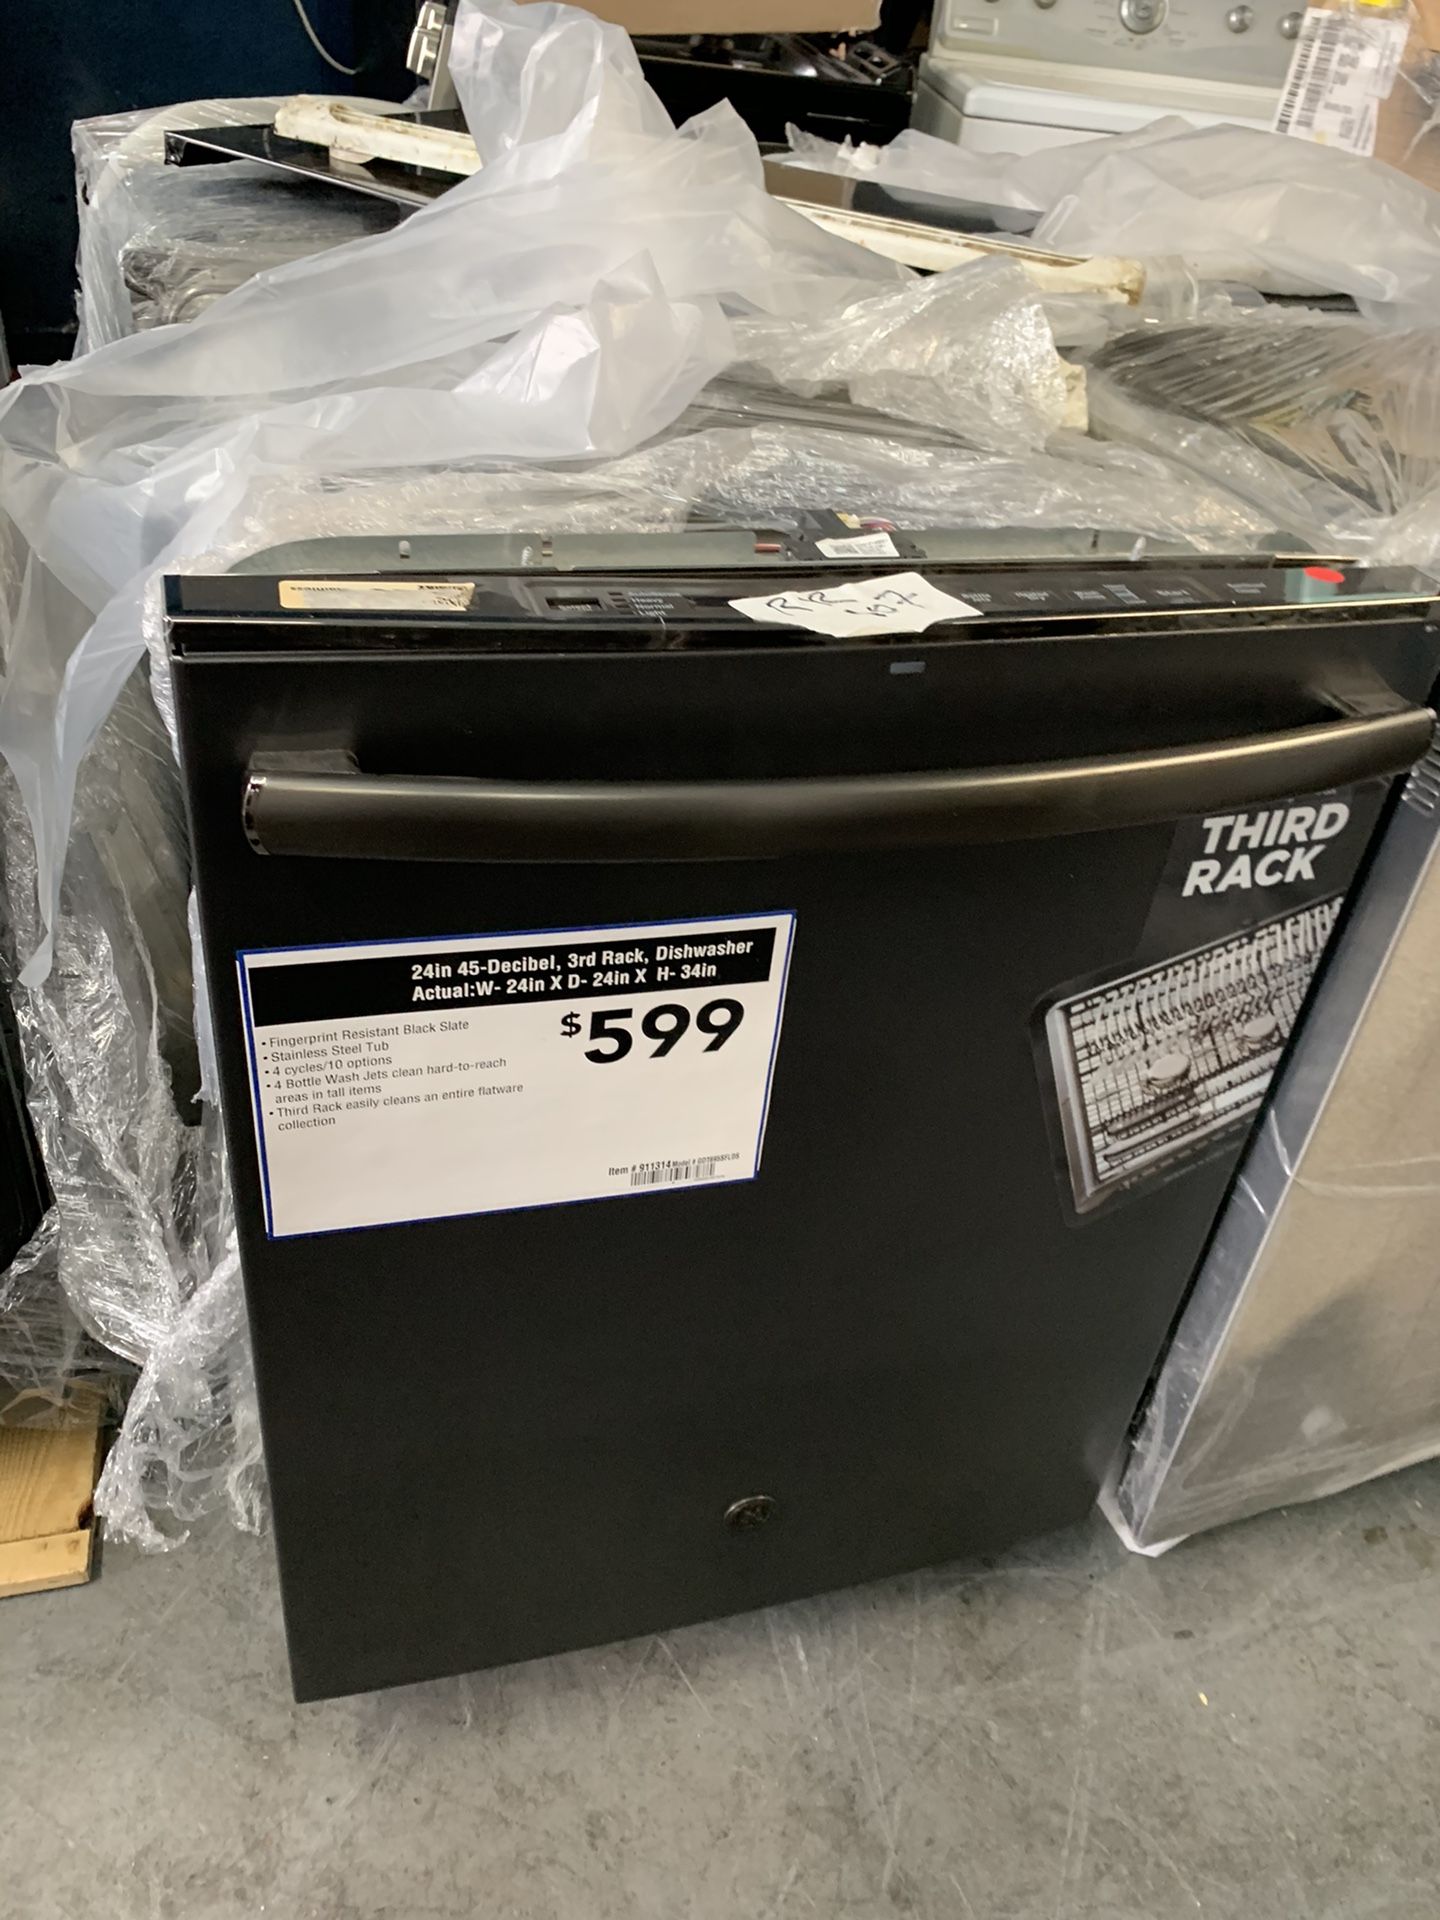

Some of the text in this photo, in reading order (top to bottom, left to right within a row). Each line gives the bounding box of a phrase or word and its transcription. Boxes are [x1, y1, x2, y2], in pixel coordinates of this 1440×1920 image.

[1202, 802, 1350, 854] THIRD
[1182, 844, 1326, 897] RACK
[411, 940, 754, 980] 24in 45-Decibel, 3rd Rack, Dishwasher
[506, 977, 545, 994] 24in
[550, 974, 563, 990] X
[567, 973, 588, 989] D-
[592, 971, 630, 988] 24in
[634, 968, 648, 984] X
[656, 966, 676, 982] H-
[680, 963, 717, 979] 34in
[269, 1019, 470, 1048] Fingerprint Resistant Black Slate
[271, 1041, 390, 1063] Stainless Steel Tub
[272, 1055, 393, 1077] 4 cycles/10 options
[273, 1058, 508, 1090] 4 Bottle Wash Jets clean hard-to-reach
[275, 1084, 383, 1104] areas in tall items
[276, 1083, 524, 1118] Third Rack easily cleans an entire flatware
[278, 1116, 337, 1131] collection
[608, 1166, 629, 1177] Item
[631, 1164, 637, 1173] #
[639, 1160, 672, 1172] 911314
[672, 1158, 691, 1168] Model
